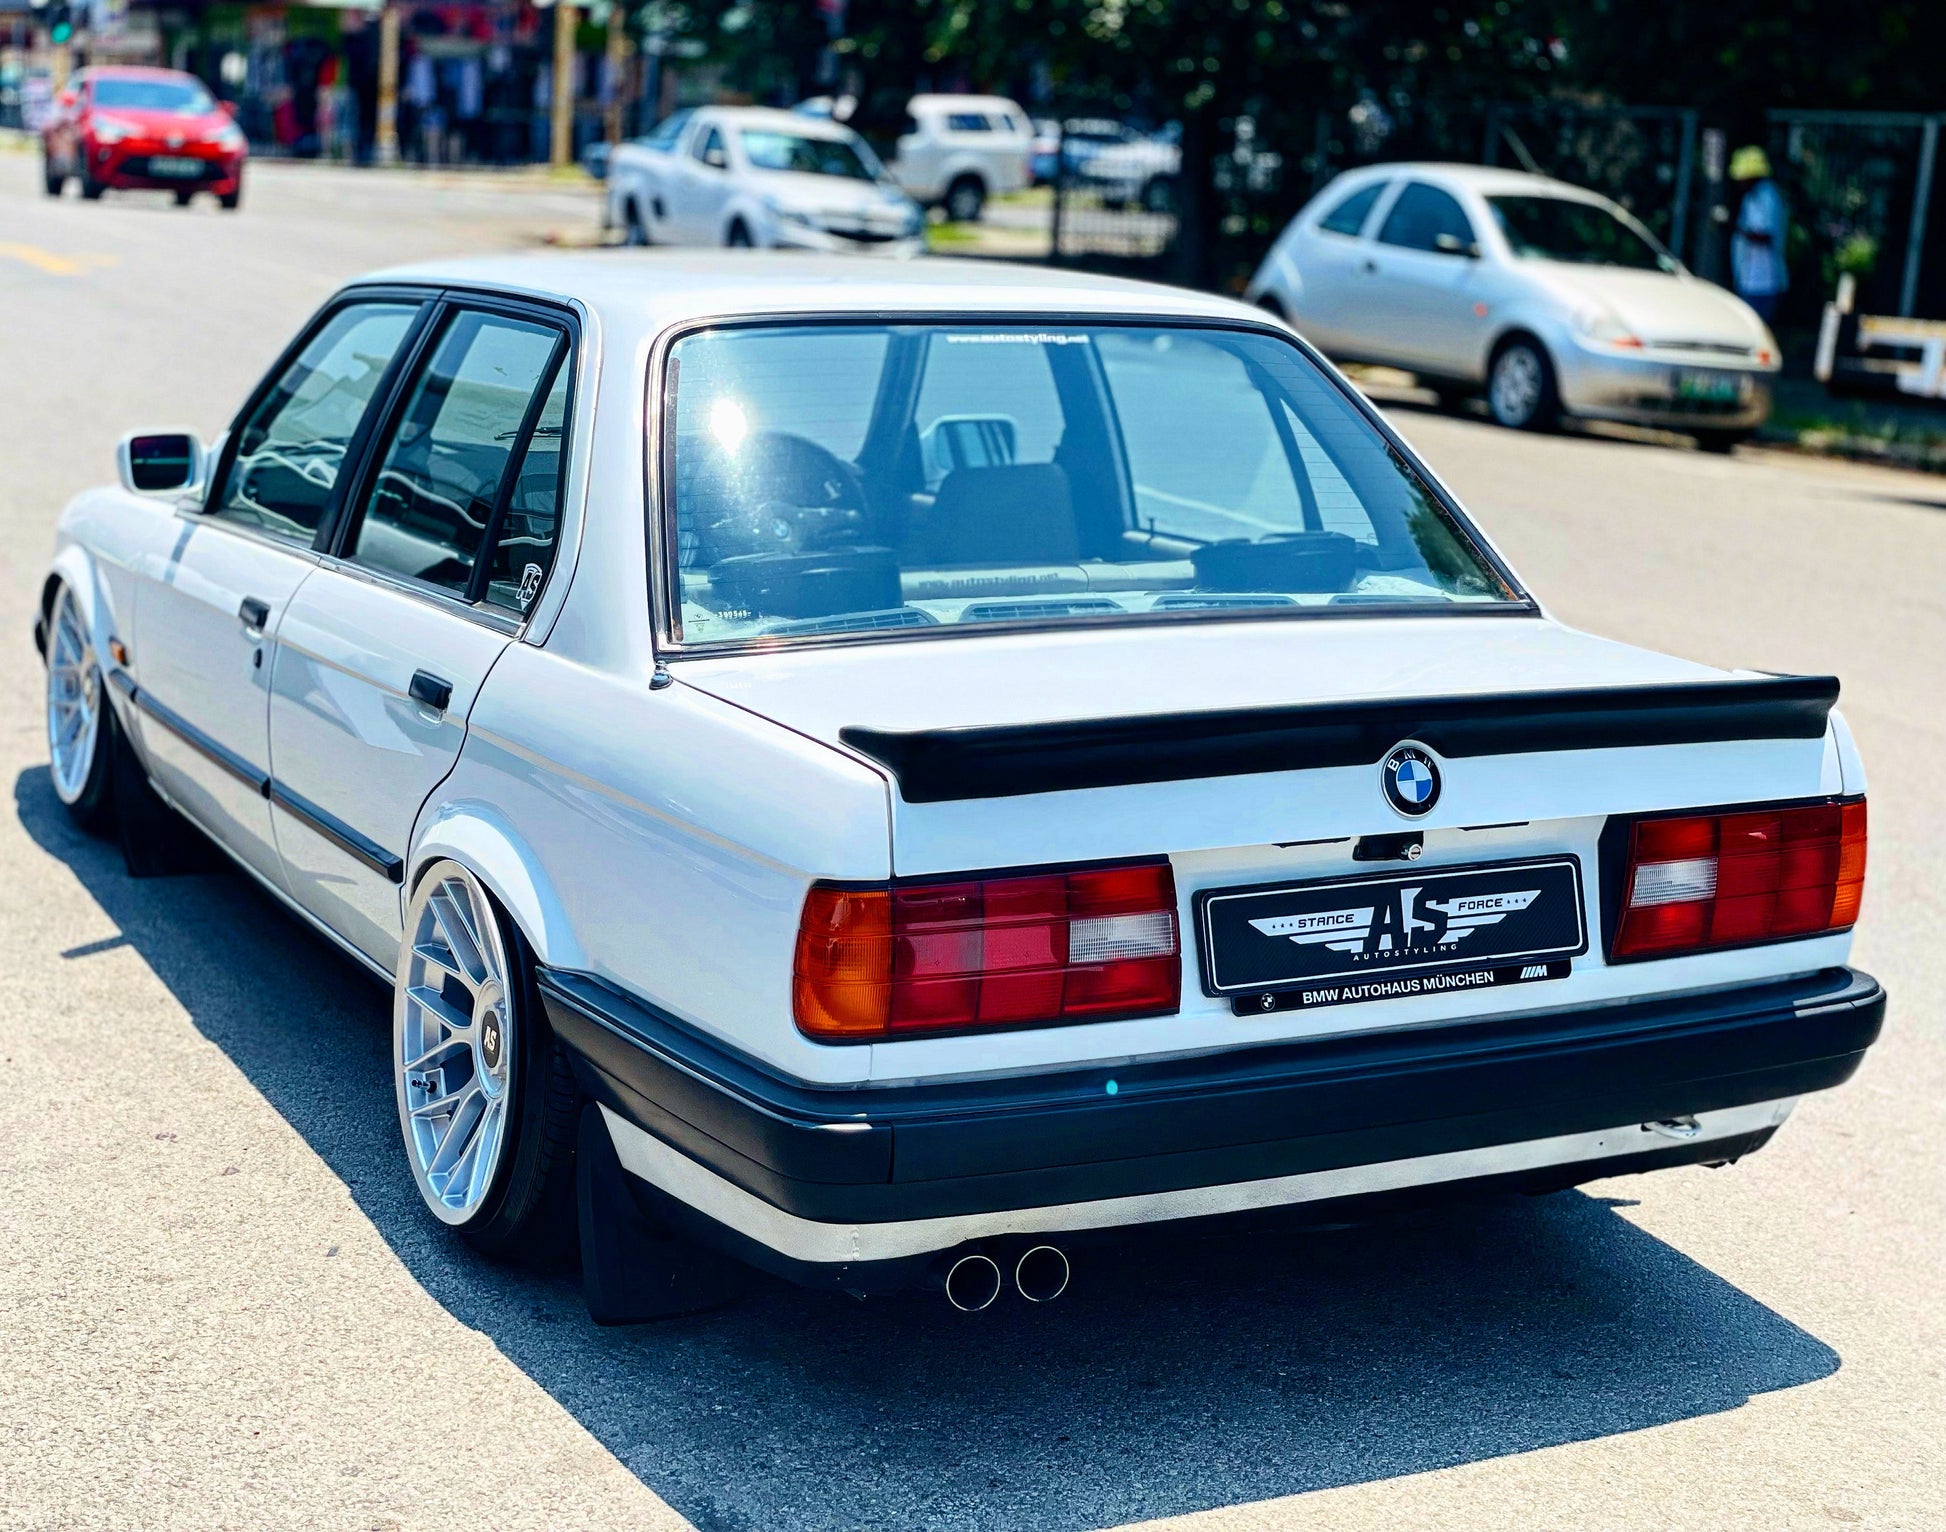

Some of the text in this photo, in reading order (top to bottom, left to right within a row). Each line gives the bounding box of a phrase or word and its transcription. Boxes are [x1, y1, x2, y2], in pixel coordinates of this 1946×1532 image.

[1387, 749, 1435, 772] BMW
[1298, 913, 1355, 928] STANCE
[1458, 898, 1503, 912] FORCE
[1353, 943, 1458, 961] AUTOSTYLING
[1302, 988, 1339, 1004] BMW
[1342, 977, 1421, 1000] AUTOHAUS
[1423, 970, 1495, 990] MÜNCHEN
[484, 1025, 498, 1052] AS
